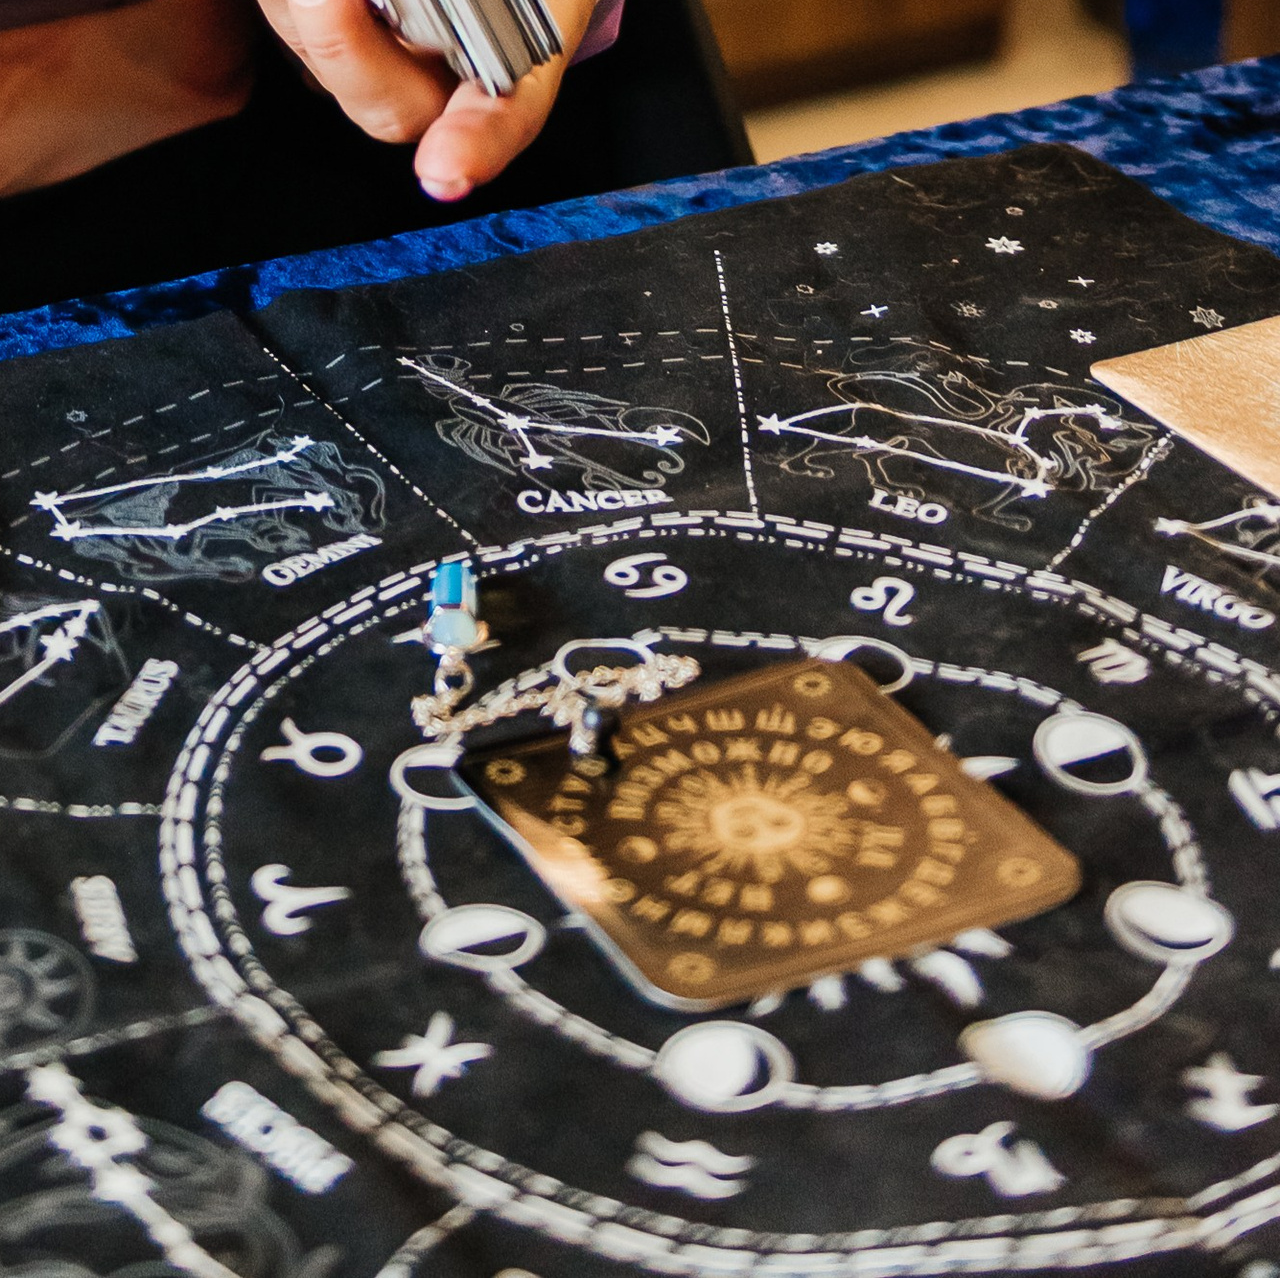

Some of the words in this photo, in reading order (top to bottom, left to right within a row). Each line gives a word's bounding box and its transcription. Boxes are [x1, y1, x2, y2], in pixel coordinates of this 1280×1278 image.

[516, 488, 673, 514] CANCER
[868, 488, 948, 525] LEO
[1160, 565, 1276, 630] VIRGO
